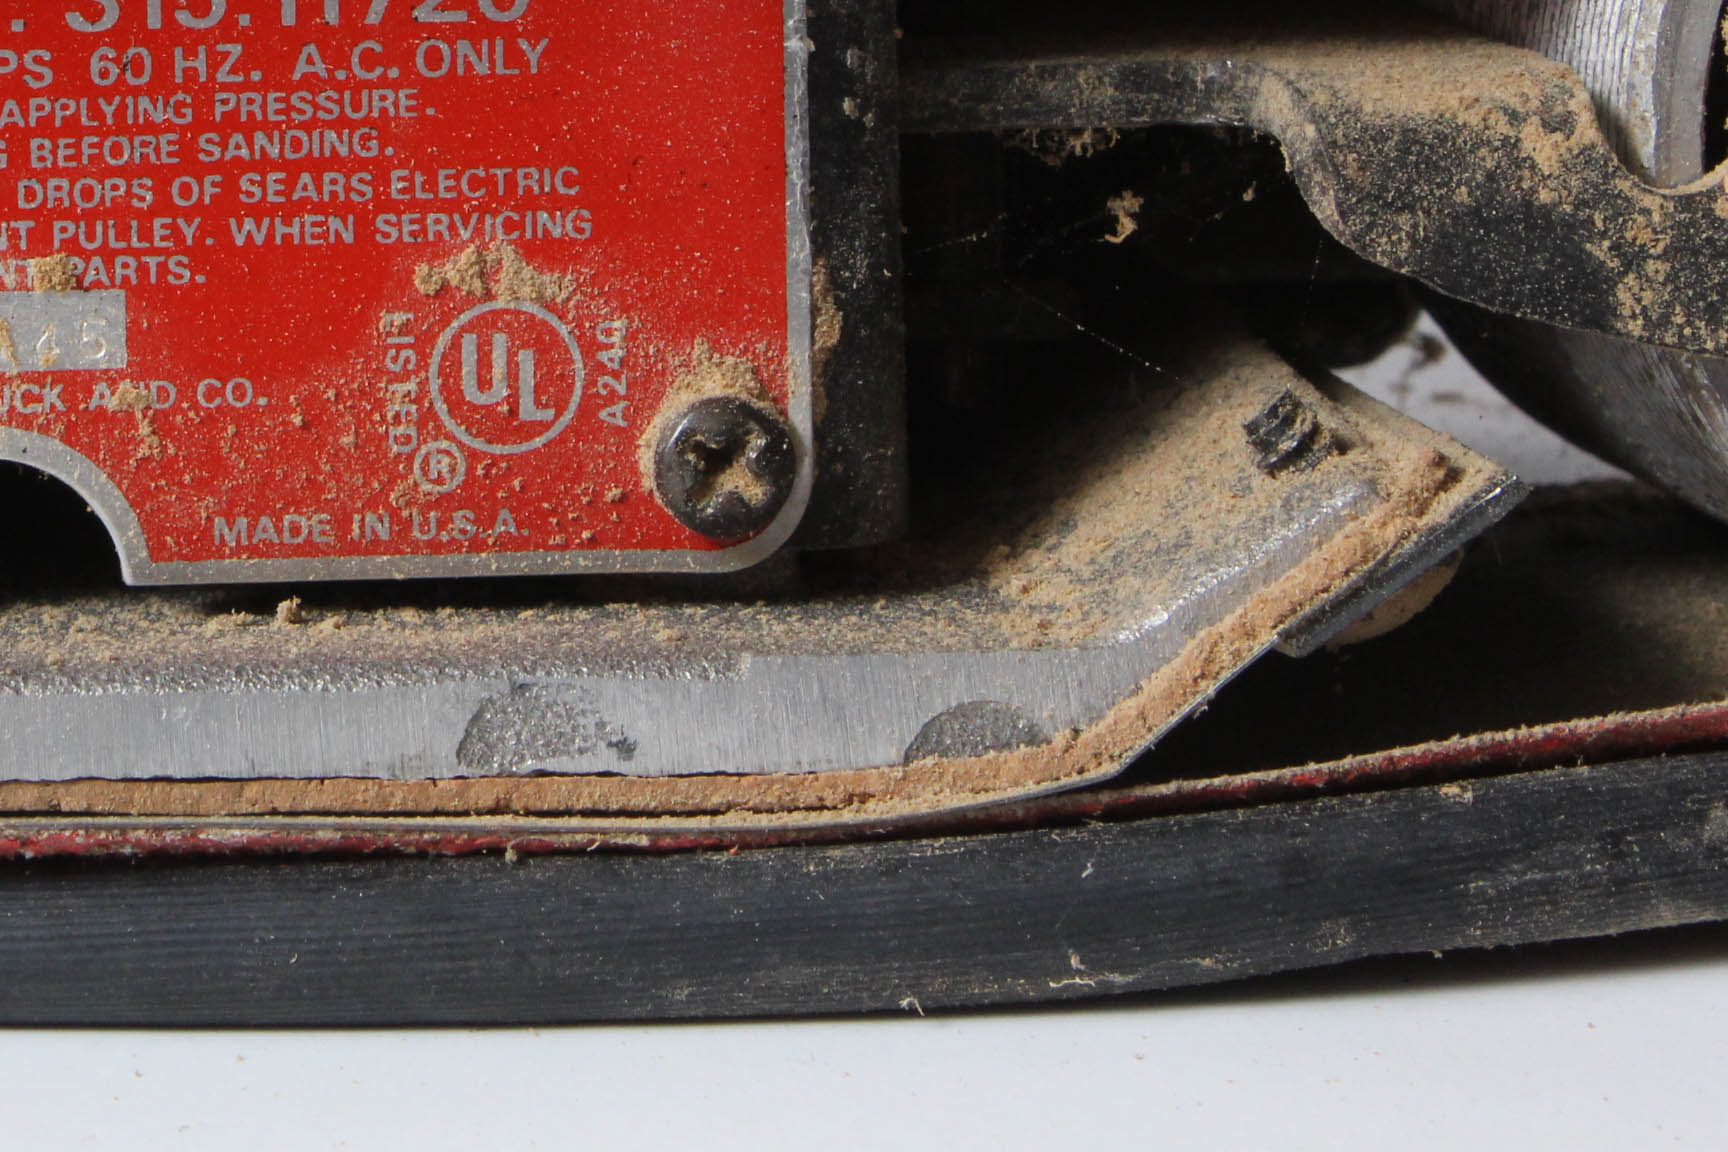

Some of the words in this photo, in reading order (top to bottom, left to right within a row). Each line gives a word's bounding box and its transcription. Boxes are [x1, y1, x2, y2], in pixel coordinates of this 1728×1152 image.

[91, 47, 152, 86] 60
[175, 44, 262, 82] HZ.
[293, 40, 399, 80] A.C.
[416, 39, 548, 77] ONLY
[215, 89, 435, 123] PRESSURE.
[30, 135, 180, 169] BEFORE
[198, 126, 395, 160] SANDING.
[18, 178, 153, 212] DROPS
[172, 176, 222, 206] OF
[240, 172, 373, 202] SEARS
[391, 166, 579, 199] ELECTRIC
[54, 218, 213, 249] PULLEY.
[230, 215, 354, 245] WHEN
[376, 210, 592, 243] SERVICING
[90, 379, 175, 410] AD
[197, 378, 268, 408] CO.
[461, 332, 556, 422] UL
[214, 514, 334, 548] MADE
[353, 510, 390, 541] IN
